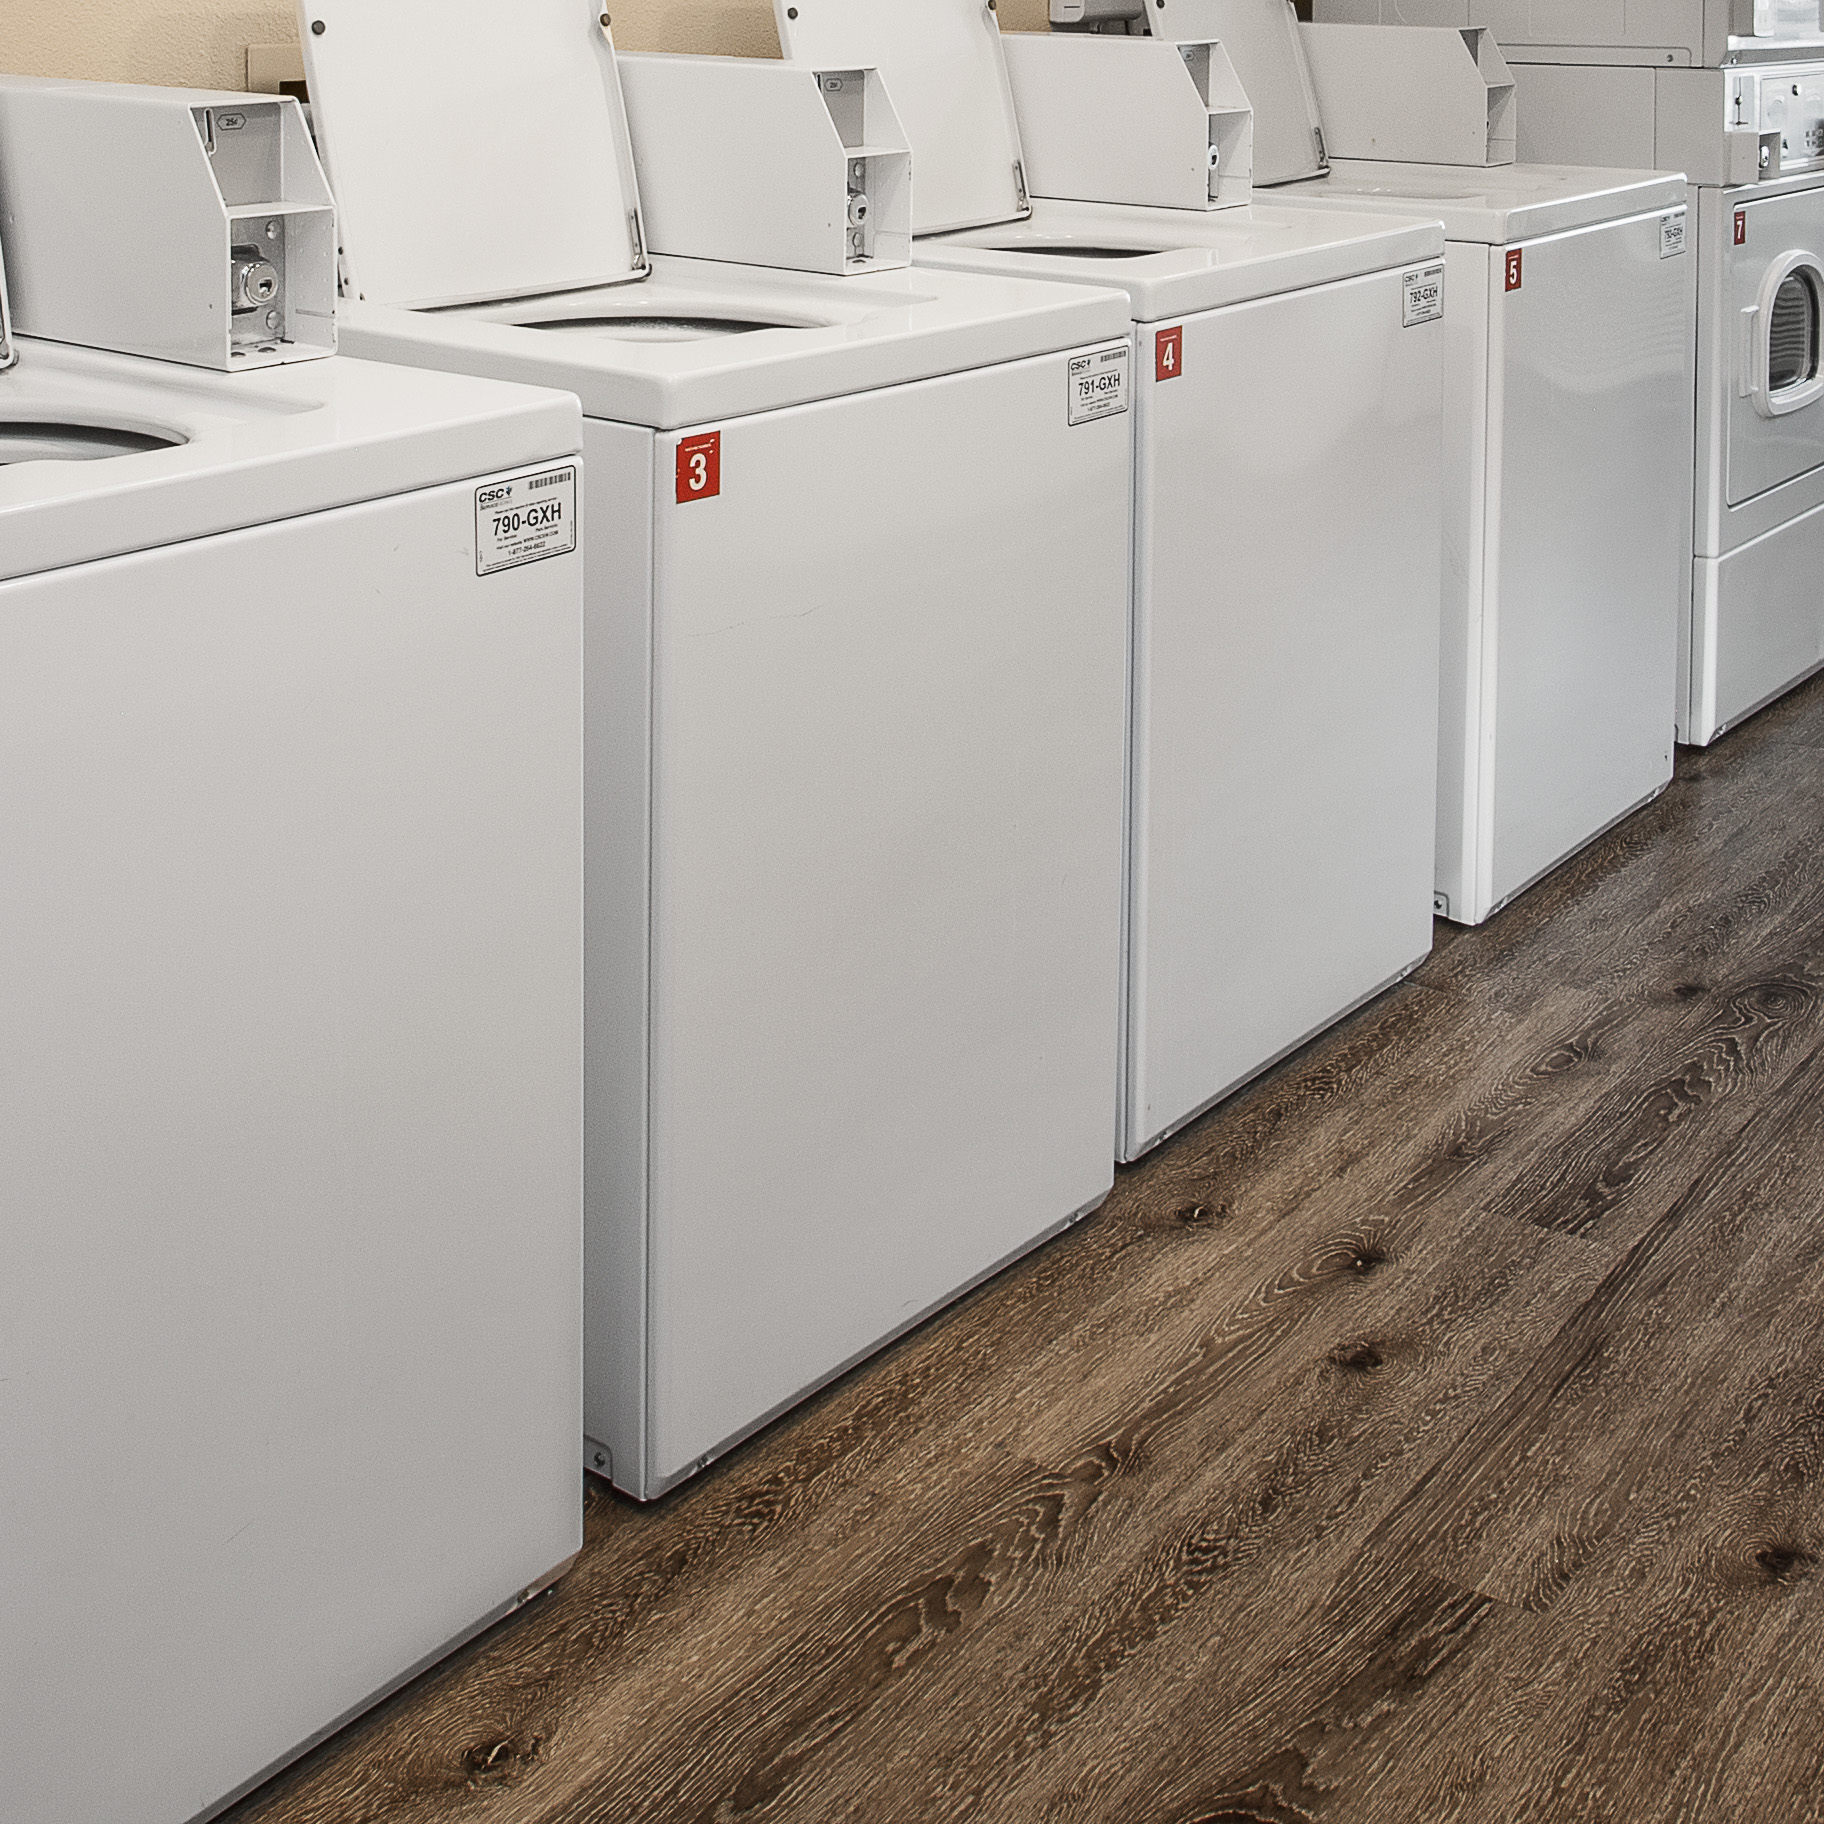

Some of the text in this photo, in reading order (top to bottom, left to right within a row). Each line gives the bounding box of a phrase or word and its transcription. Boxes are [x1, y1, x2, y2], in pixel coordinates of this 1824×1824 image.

[1737, 221, 1743, 239] 7
[1509, 261, 1517, 284] 5
[1410, 286, 1438, 304] 792-GXH
[1071, 360, 1086, 370] CSC
[1162, 343, 1174, 370] 4
[1079, 373, 1120, 396] 791-GXH
[689, 453, 706, 490] 3
[479, 489, 504, 502] CSC
[492, 502, 561, 536] 790-GXH
